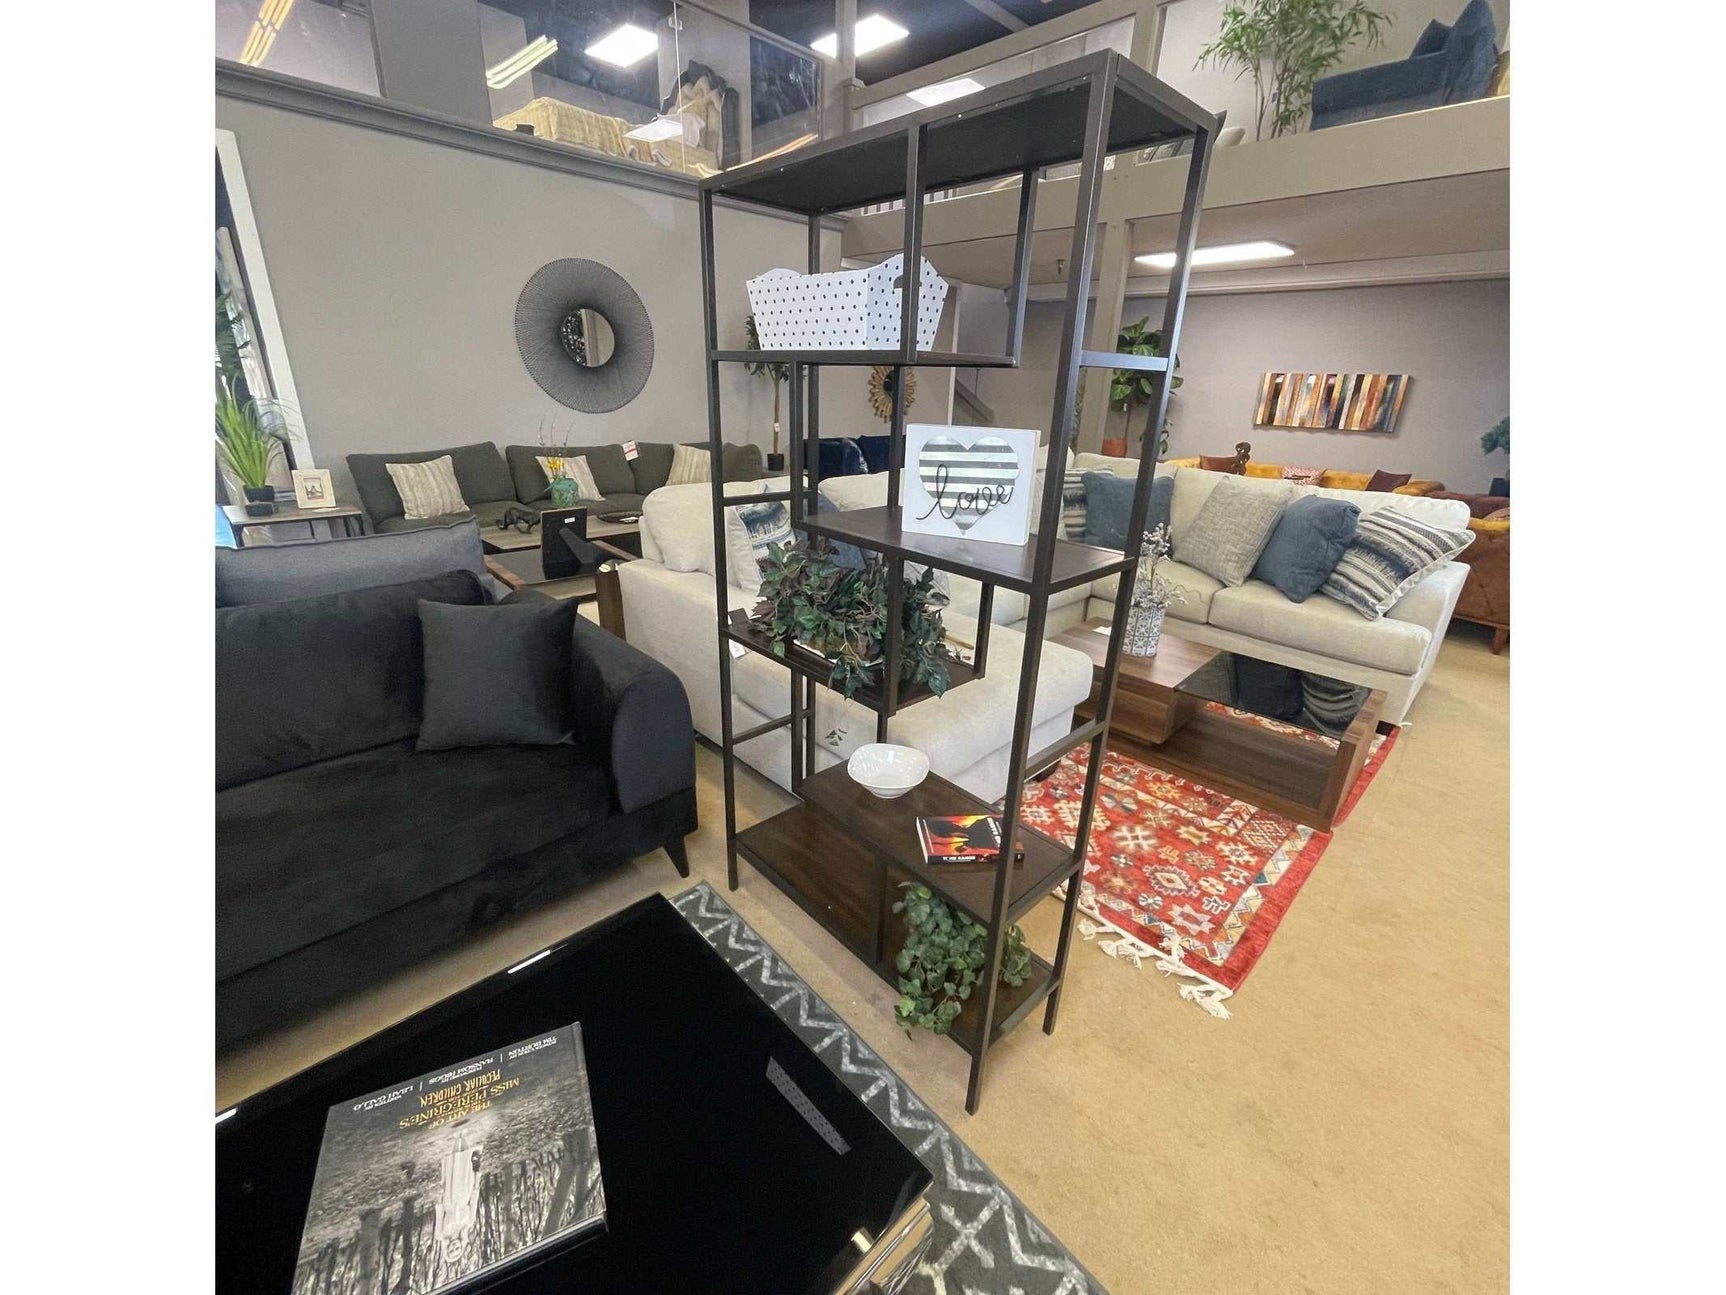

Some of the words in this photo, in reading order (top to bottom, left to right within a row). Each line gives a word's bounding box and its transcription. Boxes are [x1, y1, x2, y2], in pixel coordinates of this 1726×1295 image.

[915, 463, 1015, 521] love
[463, 1068, 501, 1091] PECULIAR
[490, 1077, 520, 1096] MISS
[419, 1083, 462, 1108] CHILDREN
[399, 1088, 487, 1129] PEREGRINE'S
[447, 1107, 469, 1121] ART
[471, 1100, 491, 1113] THE
[429, 1118, 445, 1129] OF
